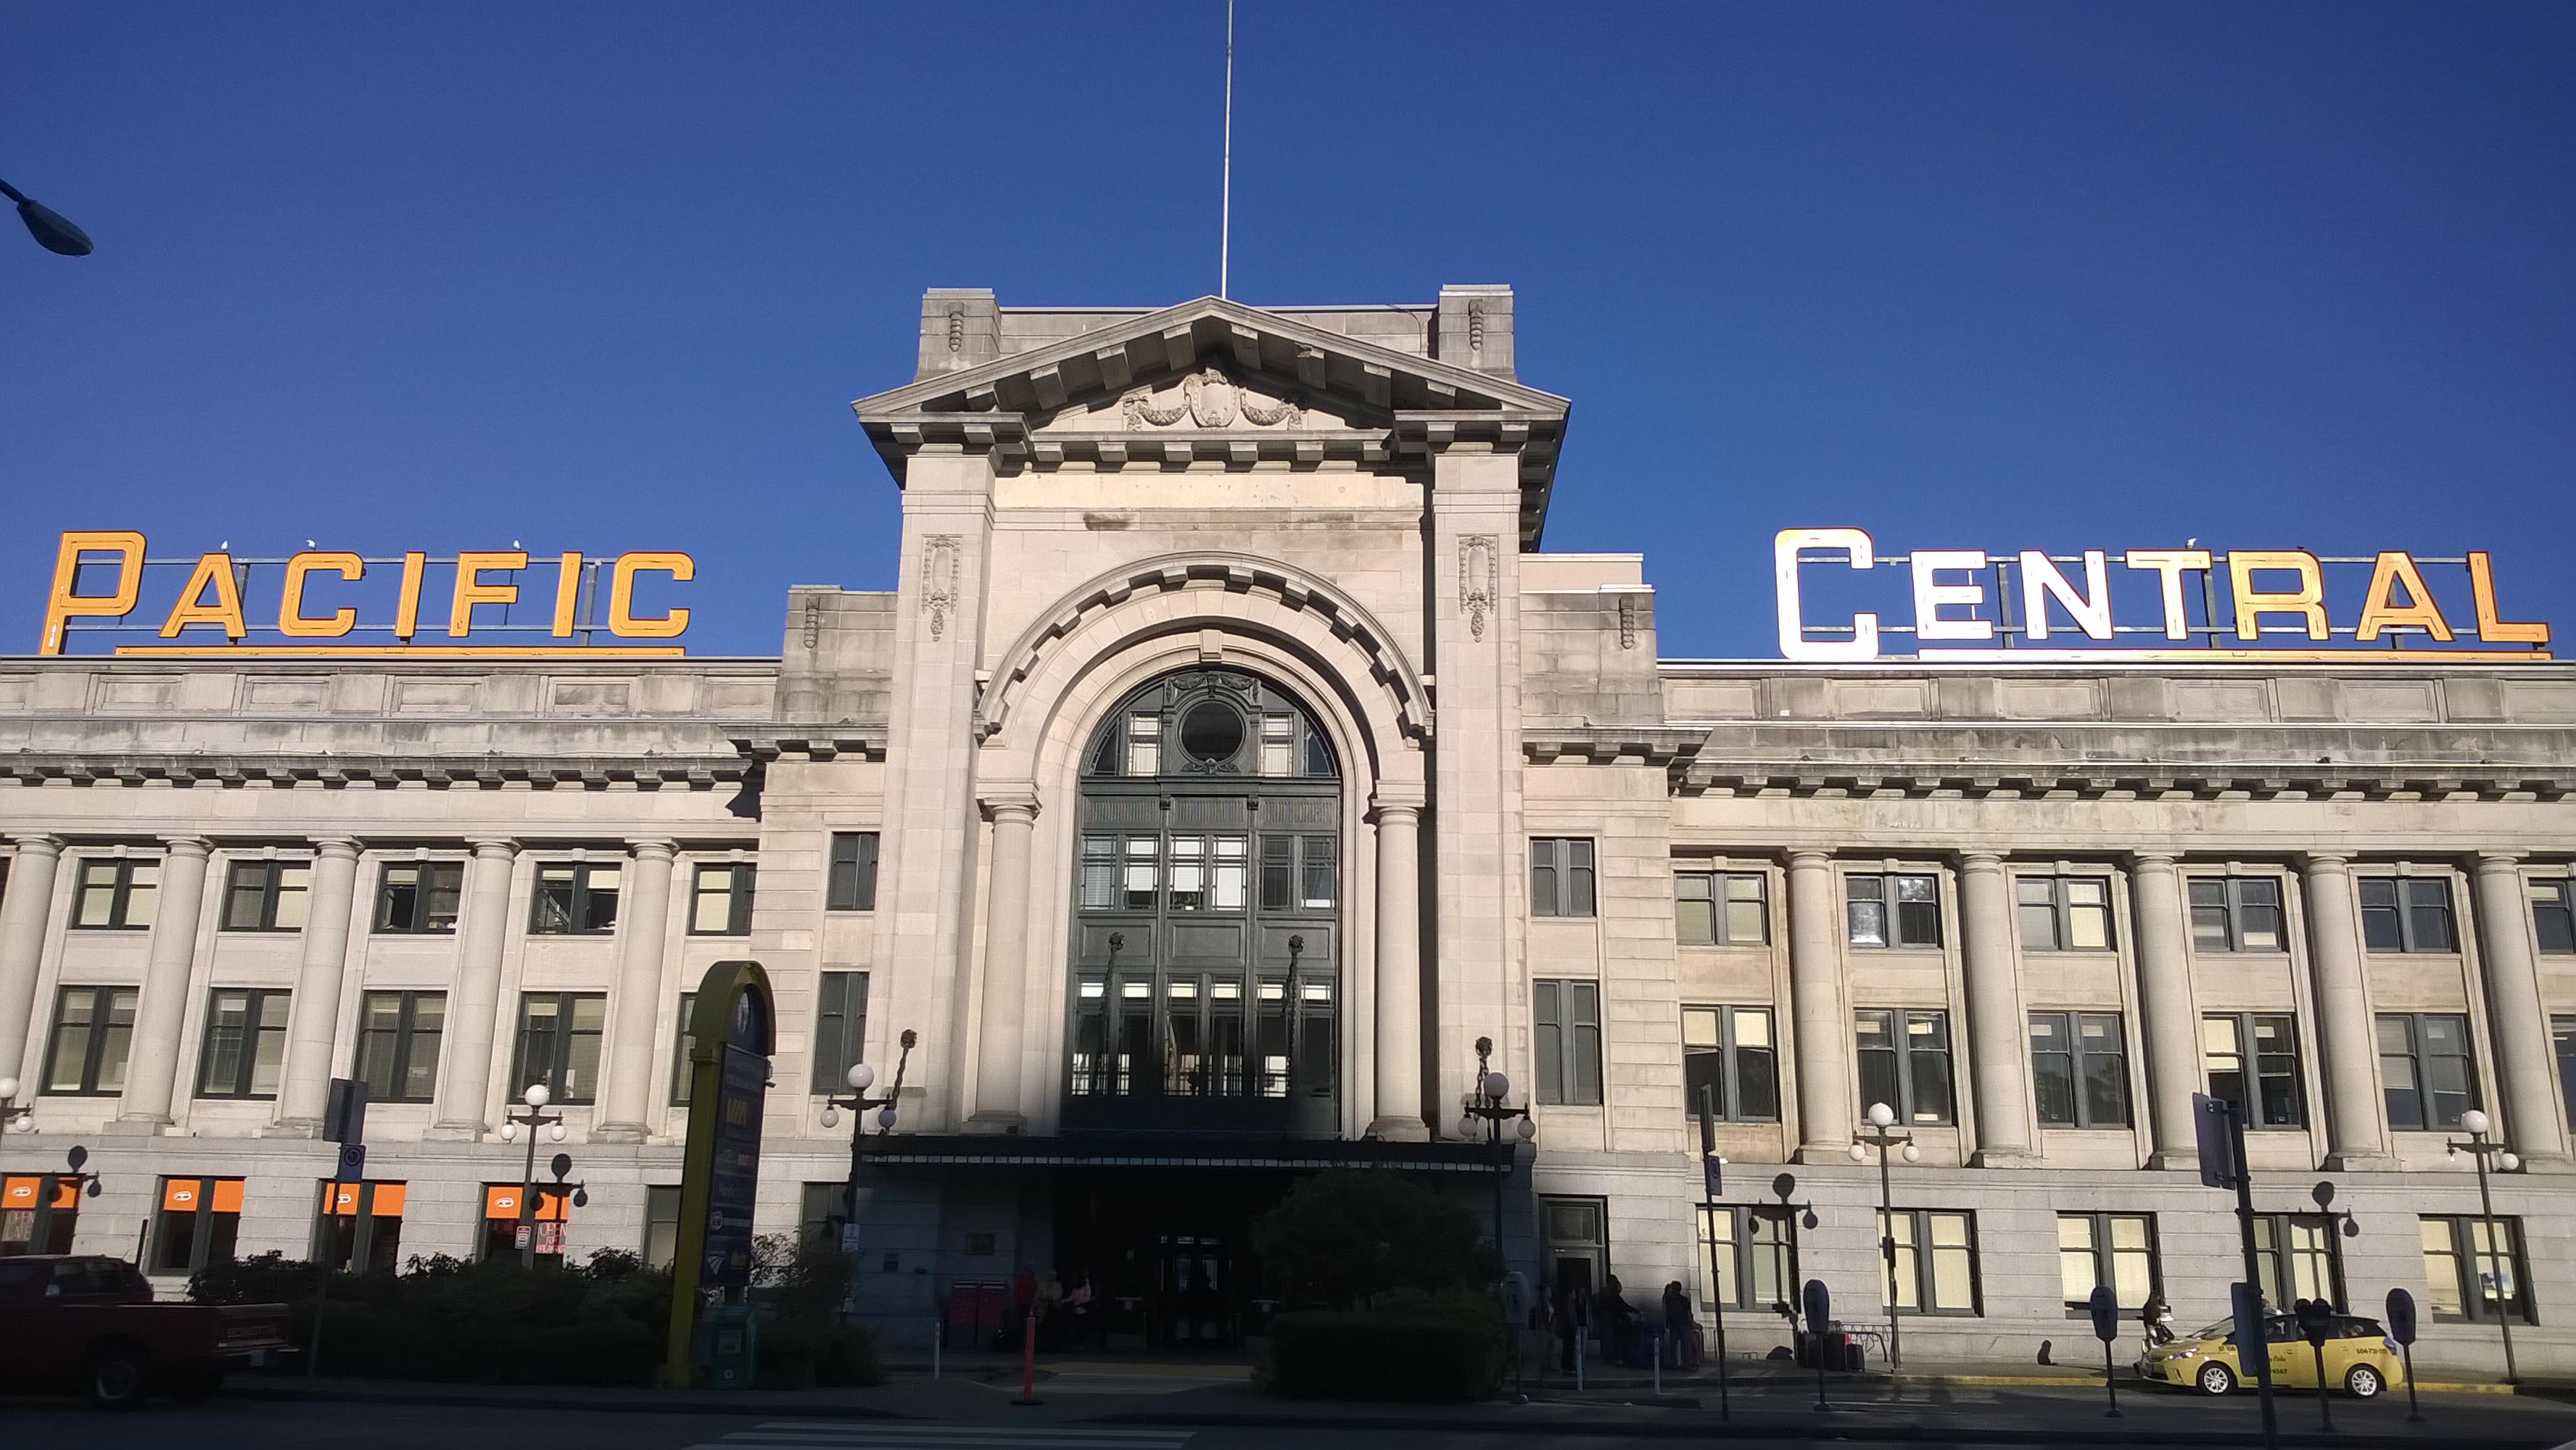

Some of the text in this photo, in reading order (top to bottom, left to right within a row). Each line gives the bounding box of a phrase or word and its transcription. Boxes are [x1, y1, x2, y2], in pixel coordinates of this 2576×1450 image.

[40, 529, 695, 656] PACIFIC
[1774, 526, 2551, 662] CENTRAL
[540, 1222, 568, 1237] OPEN
